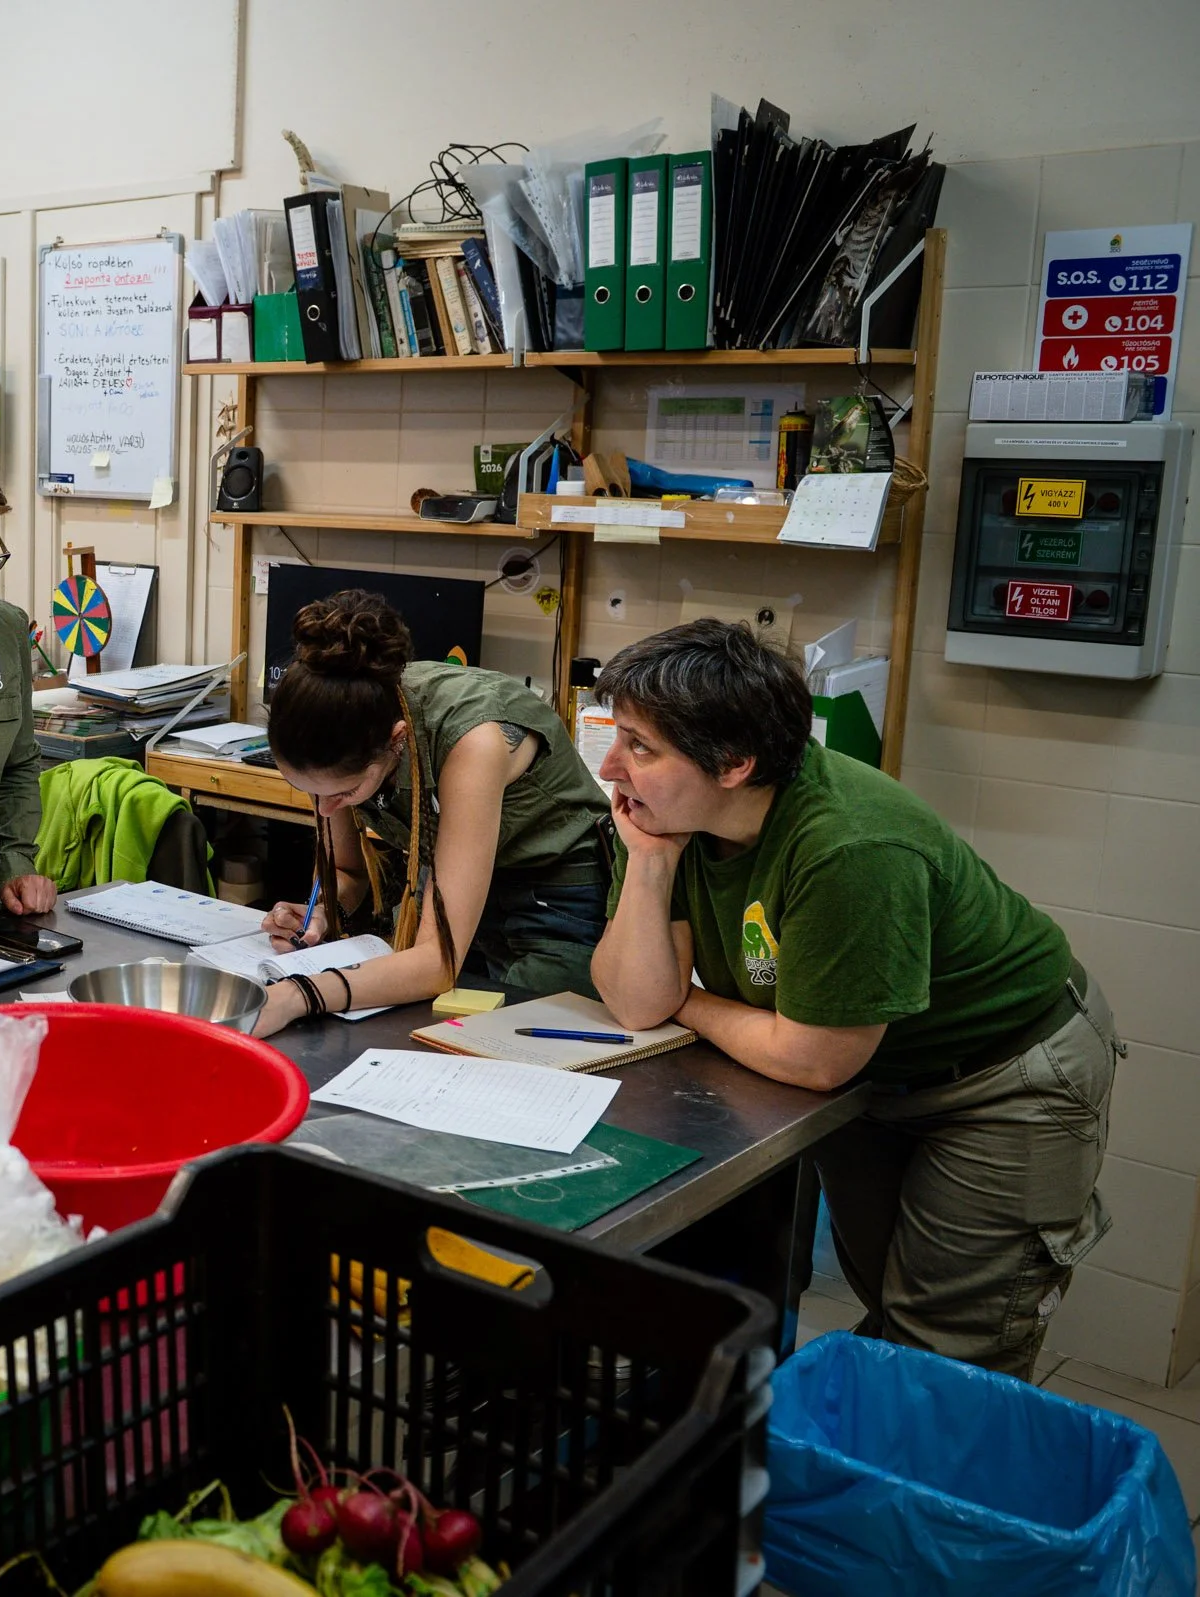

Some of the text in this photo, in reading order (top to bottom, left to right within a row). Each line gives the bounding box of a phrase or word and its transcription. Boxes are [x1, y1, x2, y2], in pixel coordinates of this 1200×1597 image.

[1057, 271, 1102, 286] S.O.S.
[1128, 274, 1169, 291] 112
[1123, 314, 1165, 332] 104
[1119, 355, 1160, 372] 105
[480, 464, 503, 473] 2026
[1047, 500, 1069, 508] 400 V
[1030, 597, 1061, 606] OLTANI
[1031, 606, 1058, 615] TILOS!
[750, 968, 777, 985] ZO
